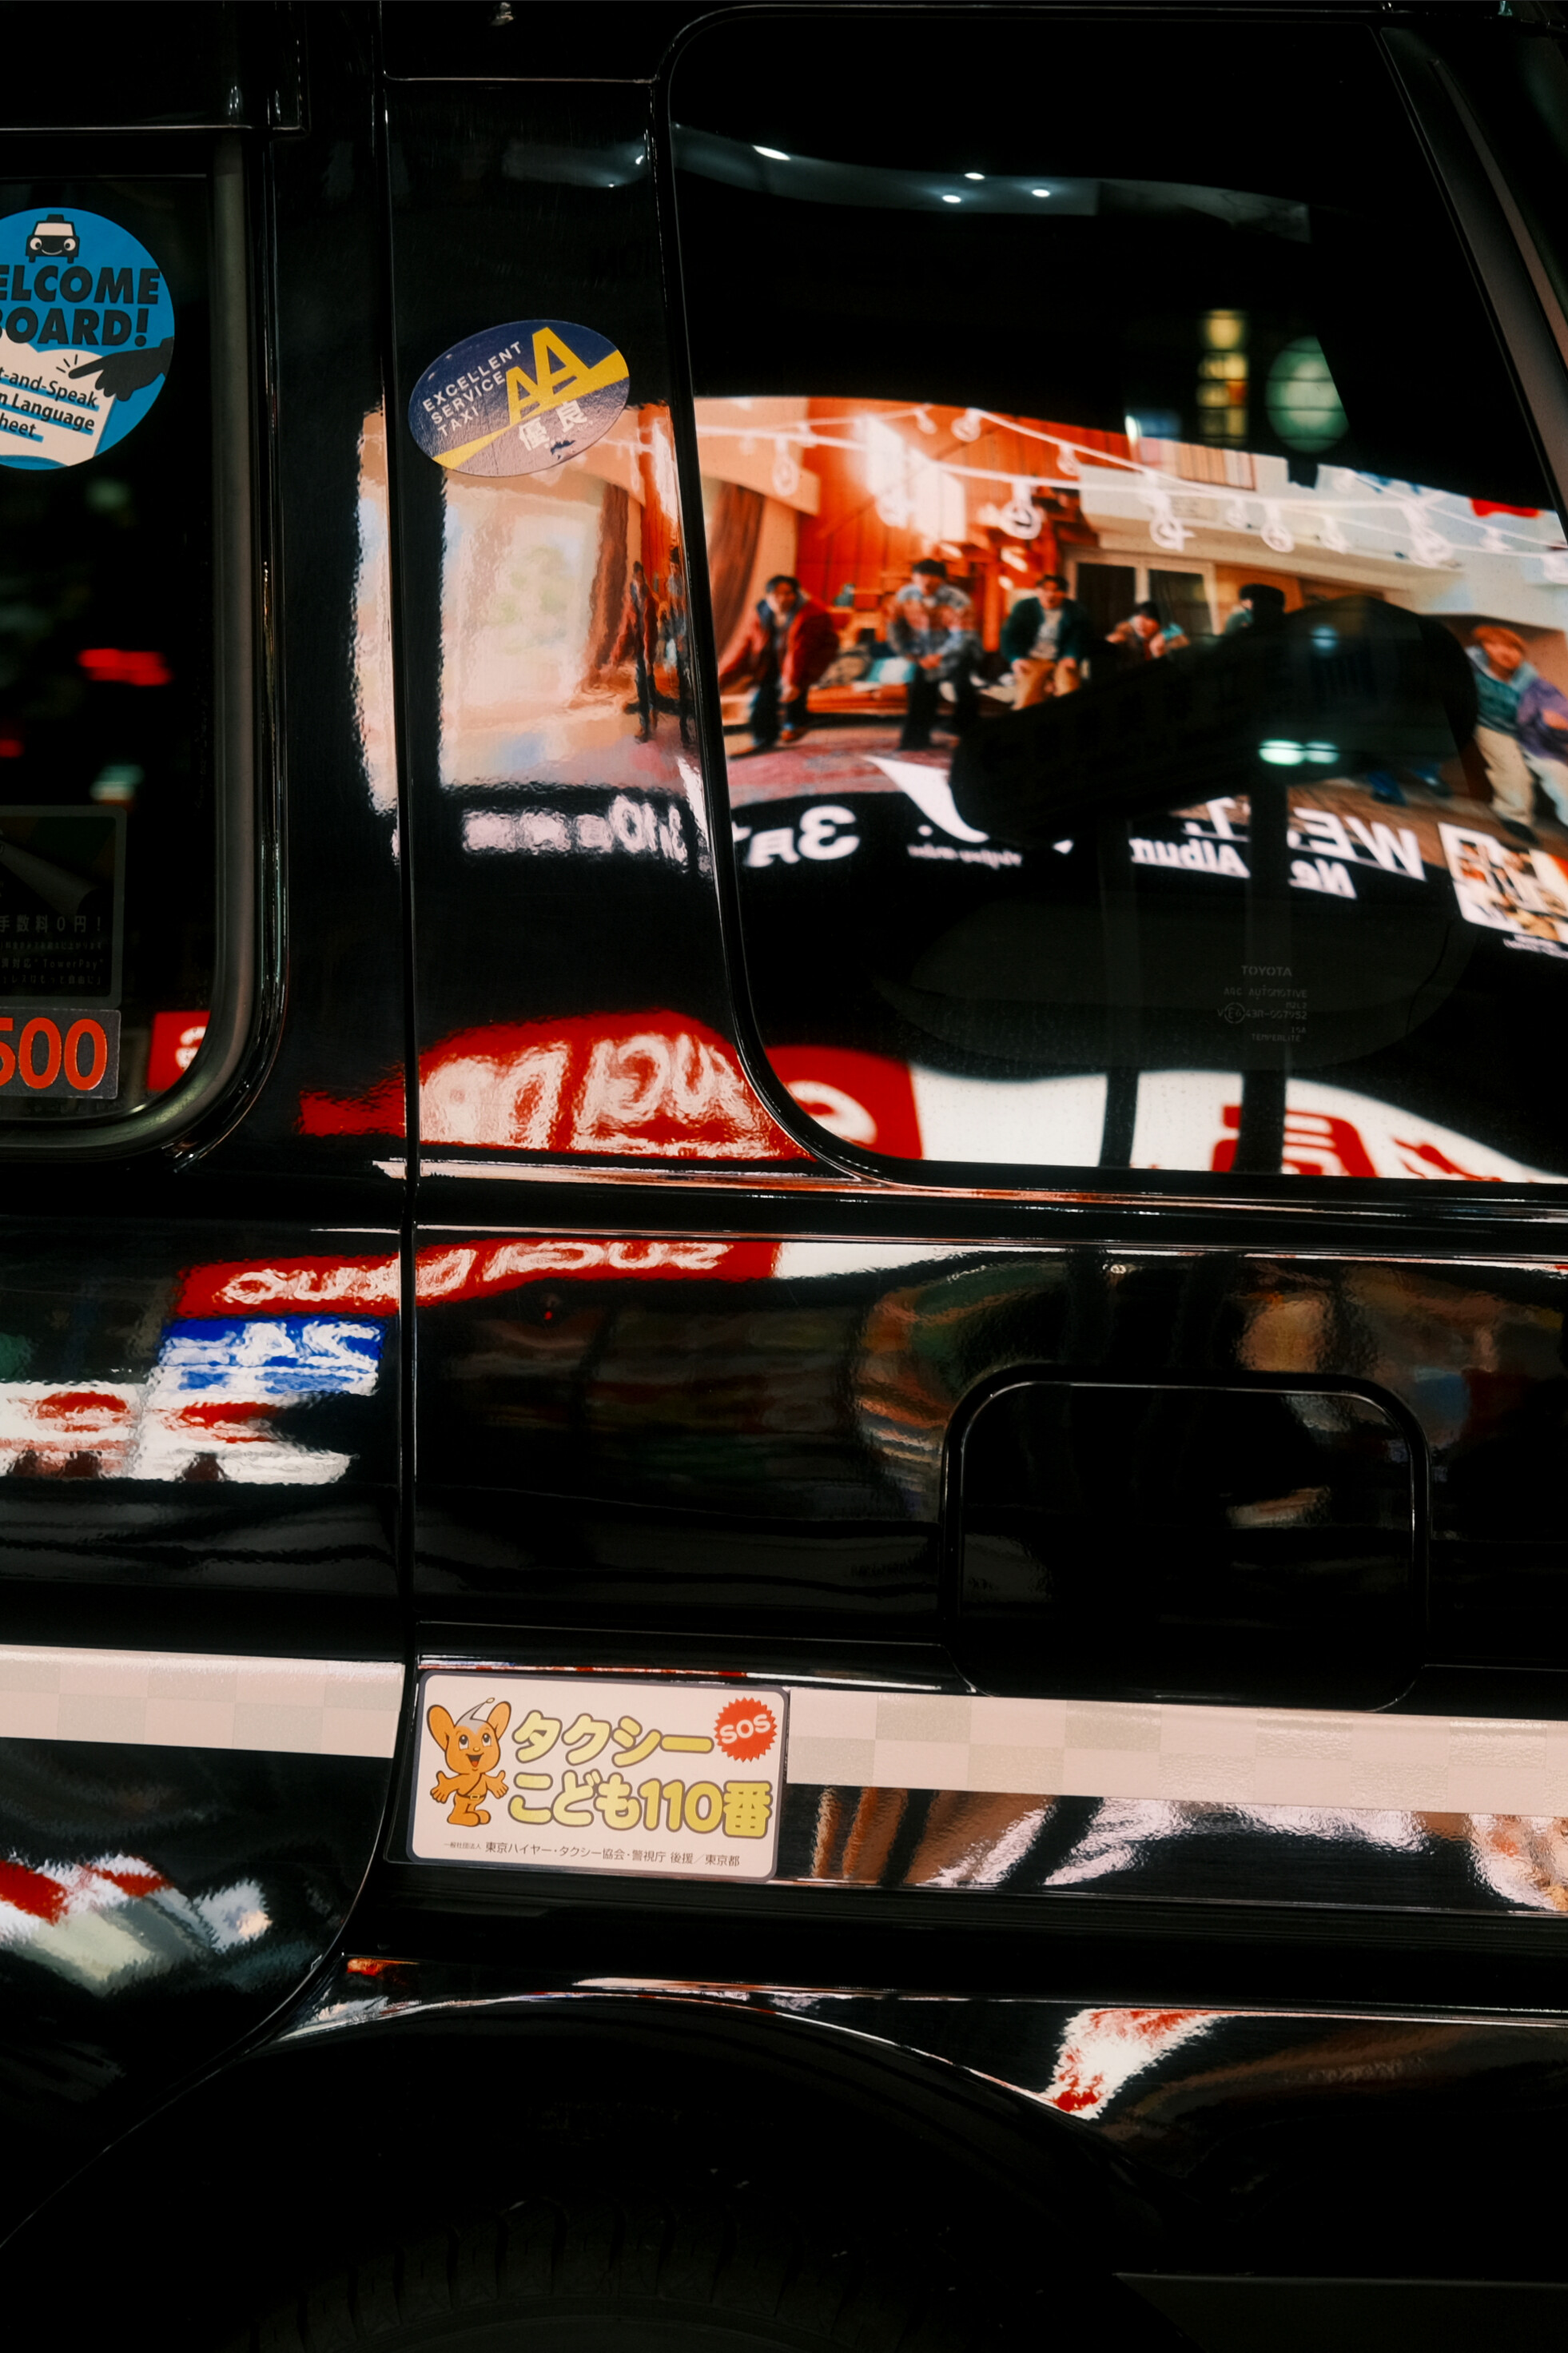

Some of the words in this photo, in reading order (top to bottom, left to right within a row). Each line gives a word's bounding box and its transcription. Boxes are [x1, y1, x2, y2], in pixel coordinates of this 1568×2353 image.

[0, 307, 149, 347] OARD!
[423, 341, 522, 412] EXCELLENT
[431, 370, 506, 425] SERVICE
[12, 393, 95, 432] Language
[437, 406, 480, 437] TAXI
[519, 400, 587, 452] 優良
[1241, 965, 1293, 977] TOYOTA
[511, 1710, 714, 1768] タクシー
[719, 1713, 771, 1744] SOS
[507, 1769, 773, 1839] こども110番
